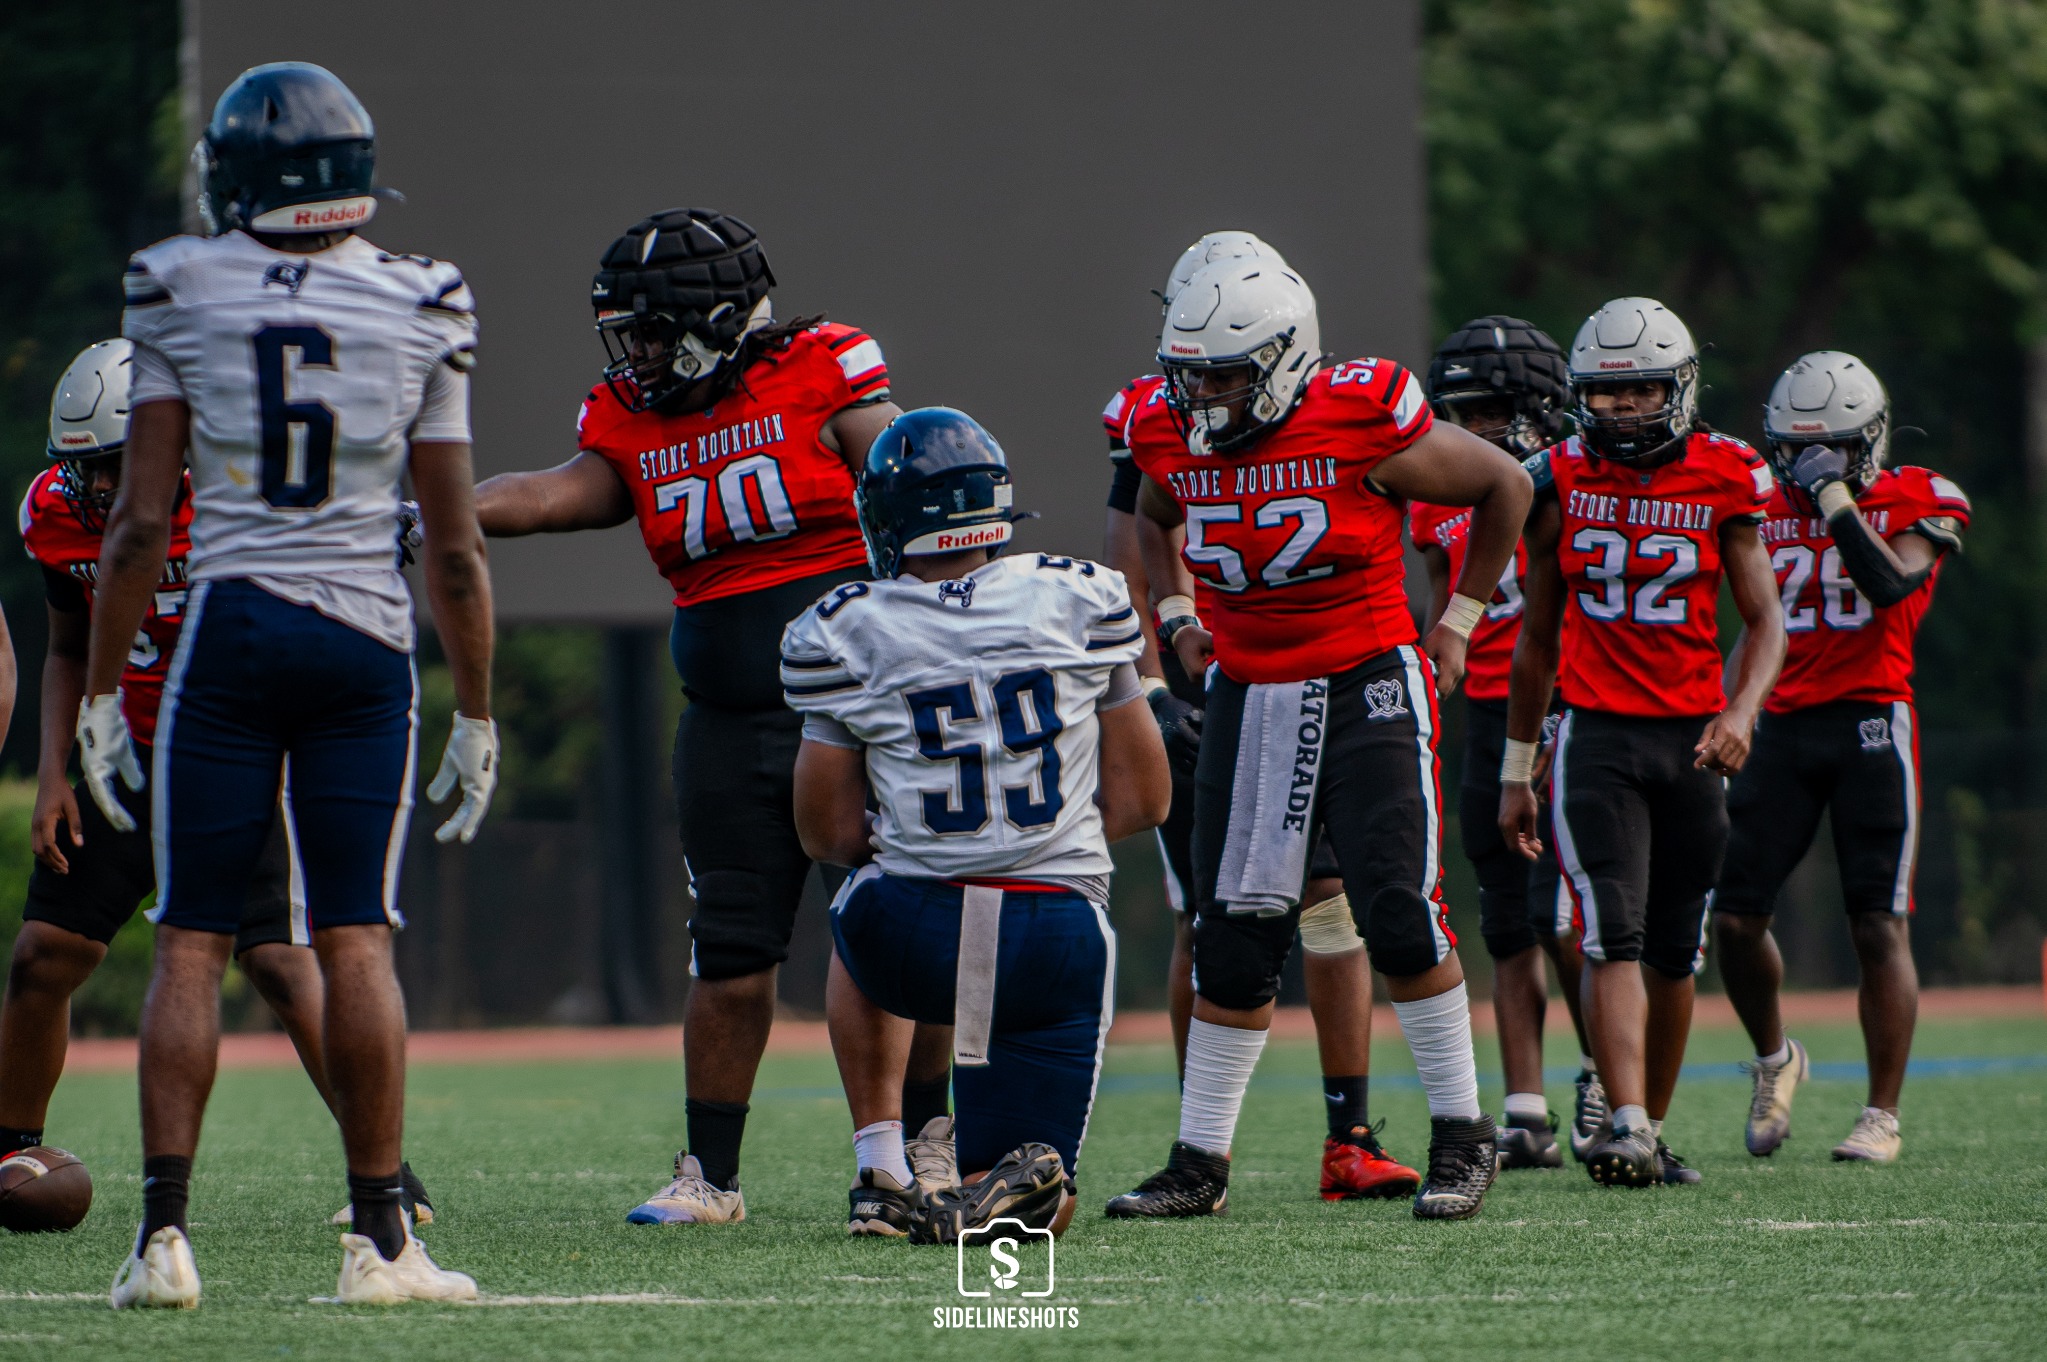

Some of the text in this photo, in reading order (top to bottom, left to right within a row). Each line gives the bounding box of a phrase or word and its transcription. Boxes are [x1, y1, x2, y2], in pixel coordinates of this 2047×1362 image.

[294, 203, 367, 225] Riddell
[1599, 361, 1632, 369] Riddell
[252, 320, 338, 512] 6
[639, 413, 785, 481] STONE MOUNTAIN
[653, 452, 799, 561] 70
[1167, 458, 1338, 498] STONE MOUNTAIN
[1568, 489, 1713, 530] STONE MOUNTAIN
[938, 526, 1004, 550] Riddell
[1181, 496, 1337, 594] 52
[1572, 527, 1700, 624] 32
[1771, 545, 1875, 631] 26
[901, 663, 1067, 837] 59
[1282, 678, 1328, 836] ATORADE
[853, 1201, 883, 1214] NIKE
